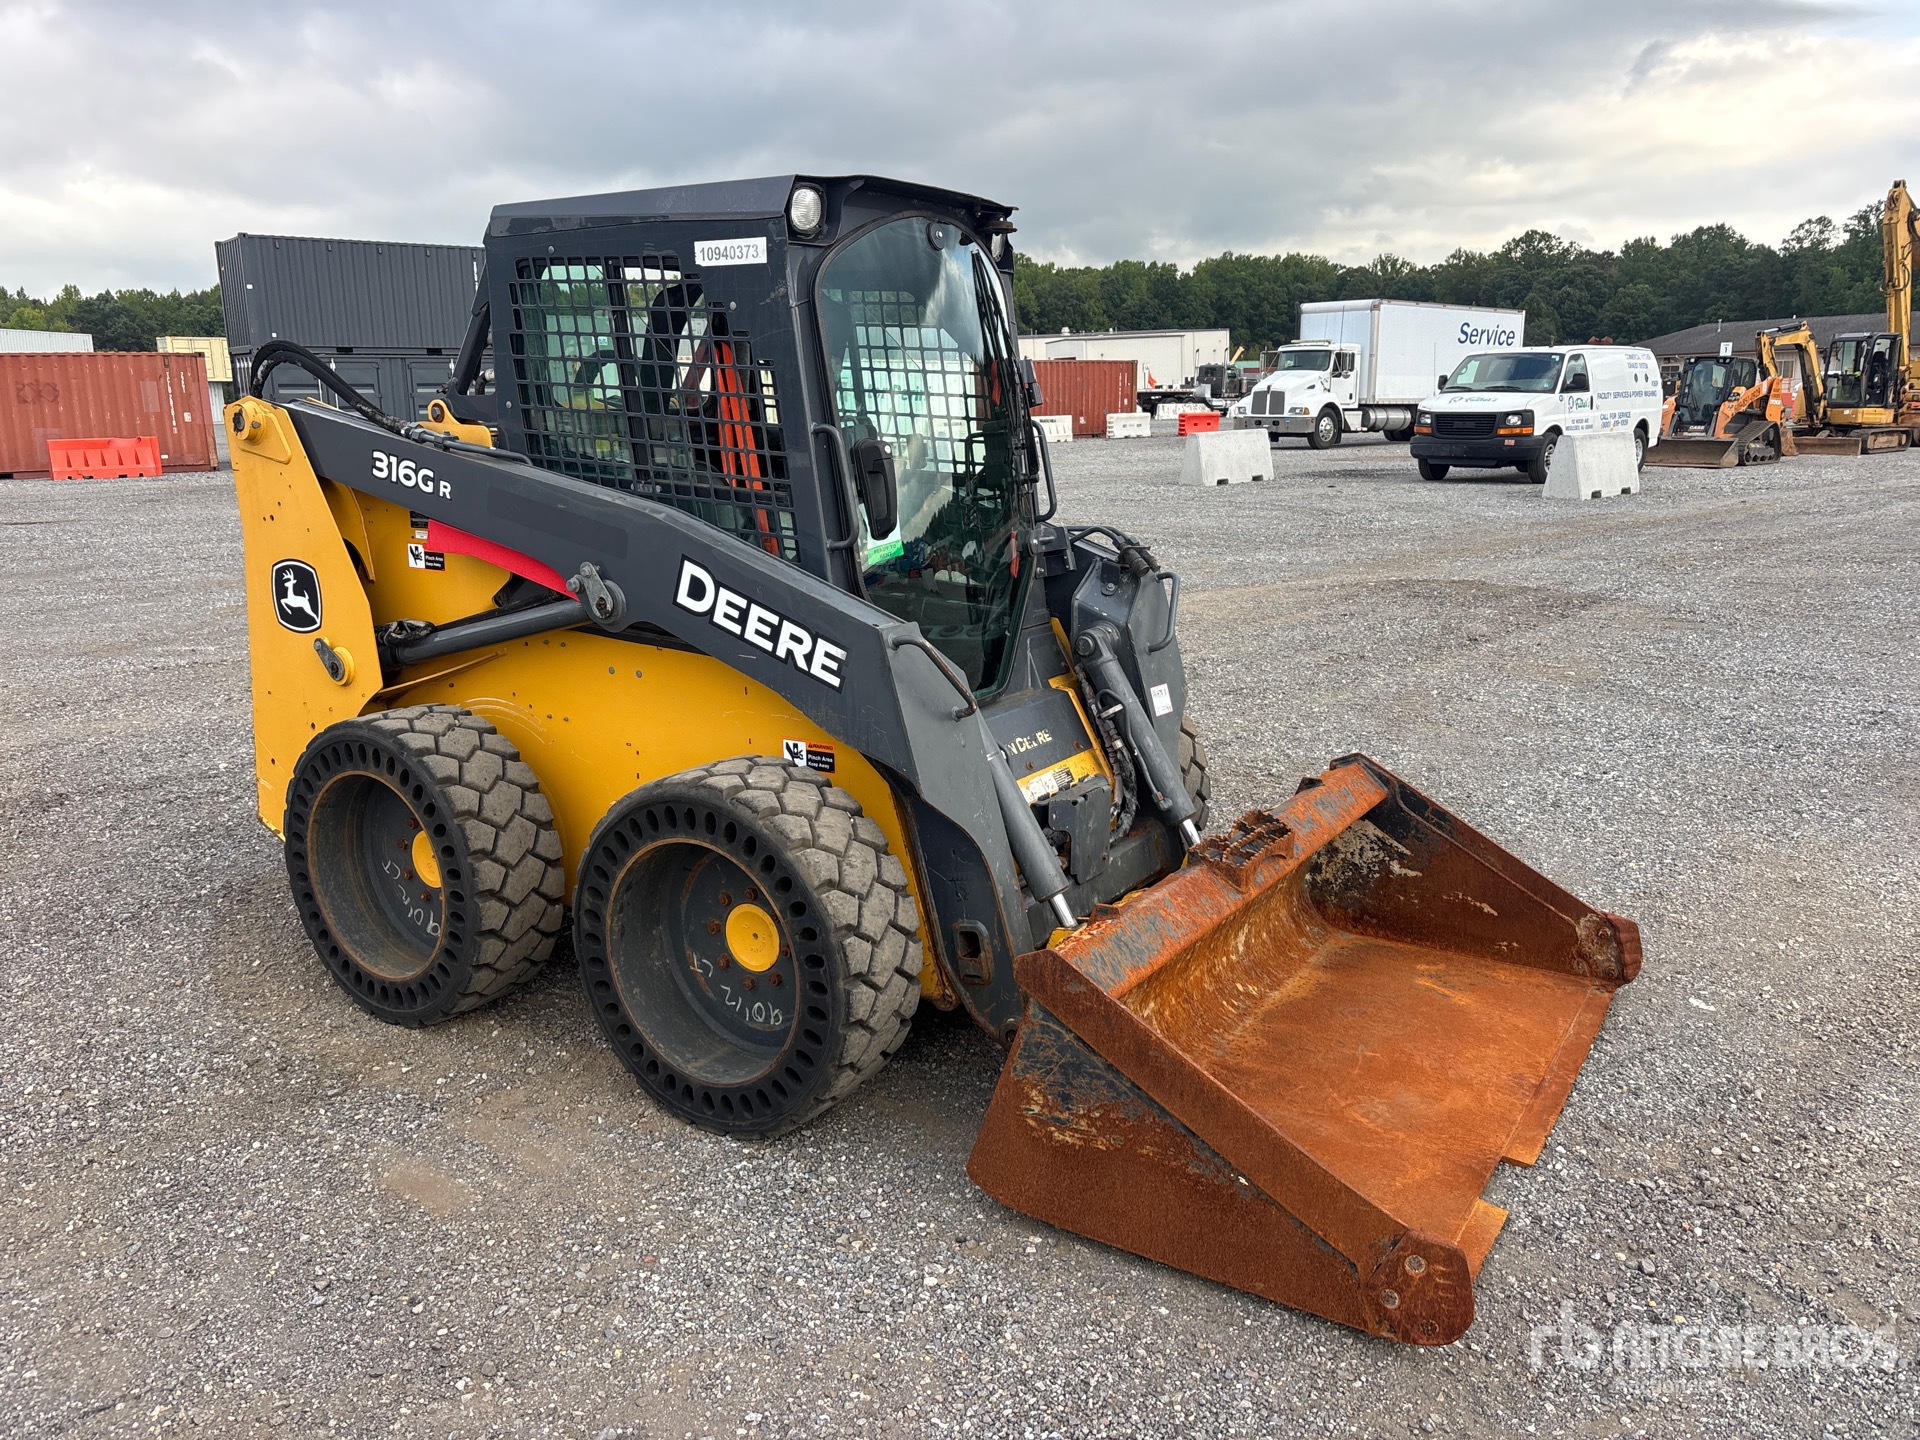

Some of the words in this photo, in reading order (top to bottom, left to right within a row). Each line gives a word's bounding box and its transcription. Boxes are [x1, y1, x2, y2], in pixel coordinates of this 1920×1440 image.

[1457, 321, 1516, 347] Service
[1600, 412, 1609, 421] CALL
[1609, 411, 1617, 420] FOR
[1617, 410, 1631, 419] SERVICE
[372, 450, 435, 493] 316G
[439, 480, 452, 500] R
[676, 559, 848, 688] DEERE
[808, 753, 822, 761] Pinch
[818, 762, 830, 770] Away
